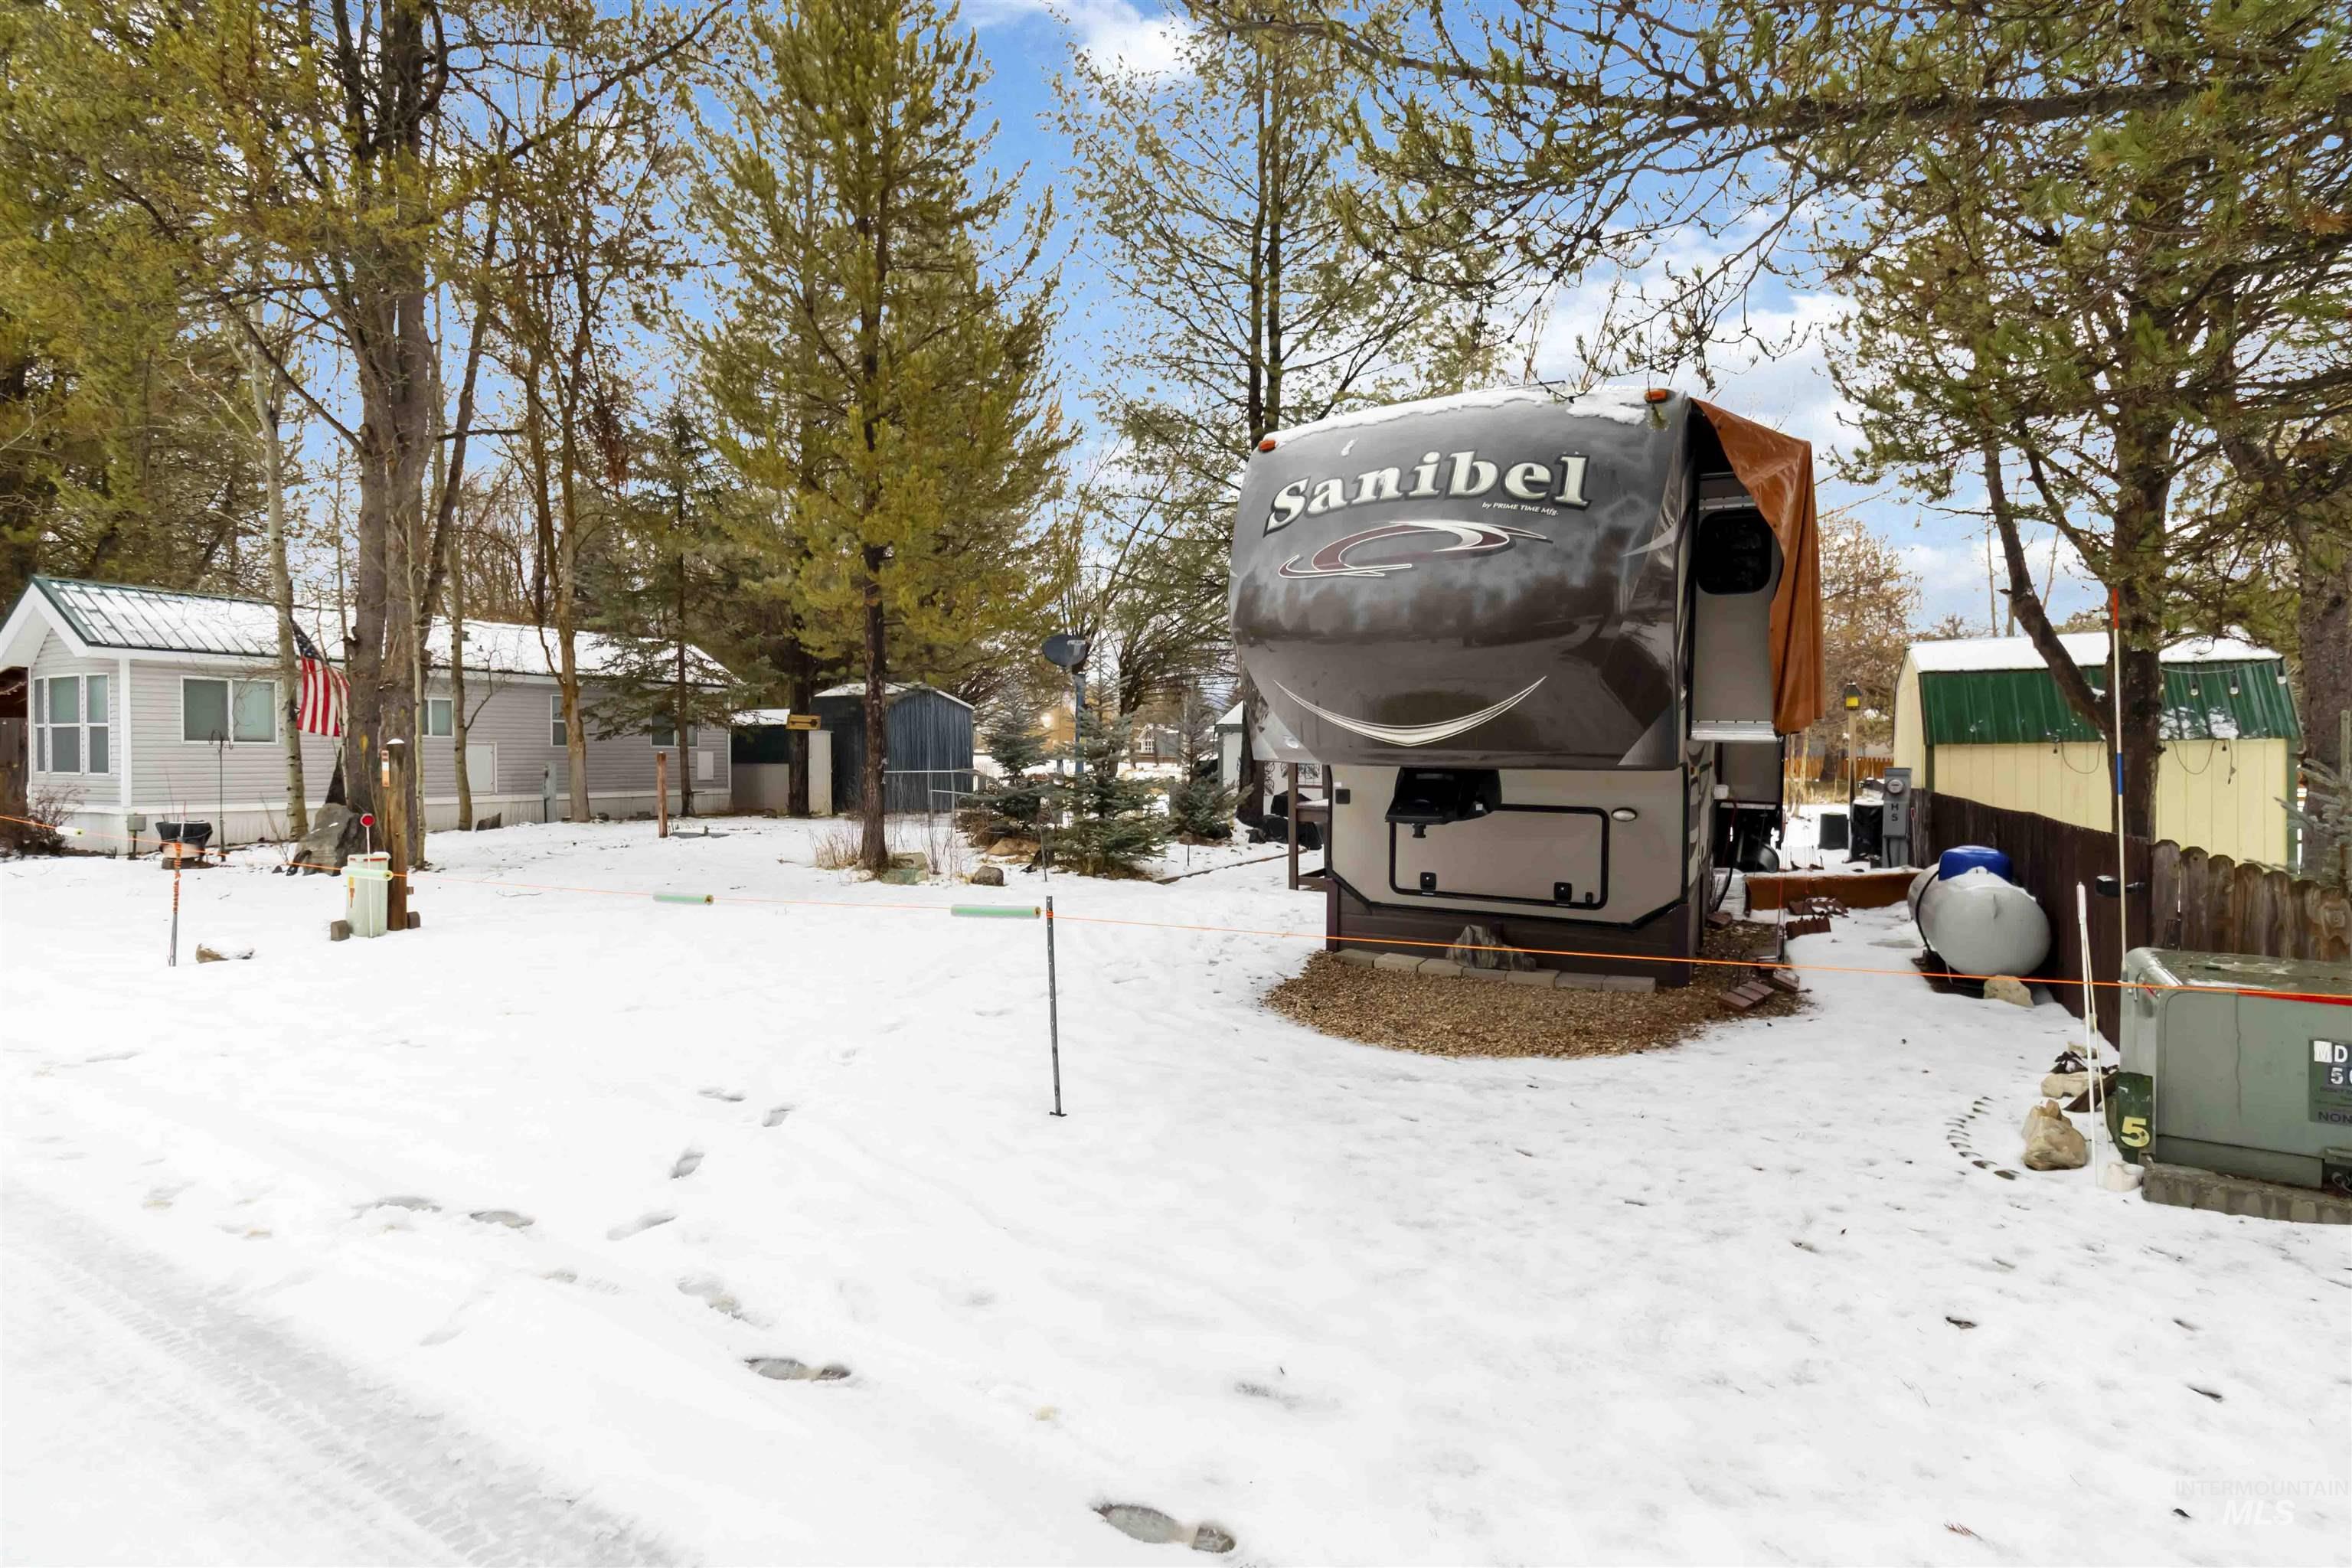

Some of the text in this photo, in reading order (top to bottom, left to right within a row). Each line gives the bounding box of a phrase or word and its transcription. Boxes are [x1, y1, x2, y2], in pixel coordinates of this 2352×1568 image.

[1264, 450, 1589, 534] Sanibel
[1520, 505, 1540, 513] TIME
[2120, 1116, 2151, 1147] 5
